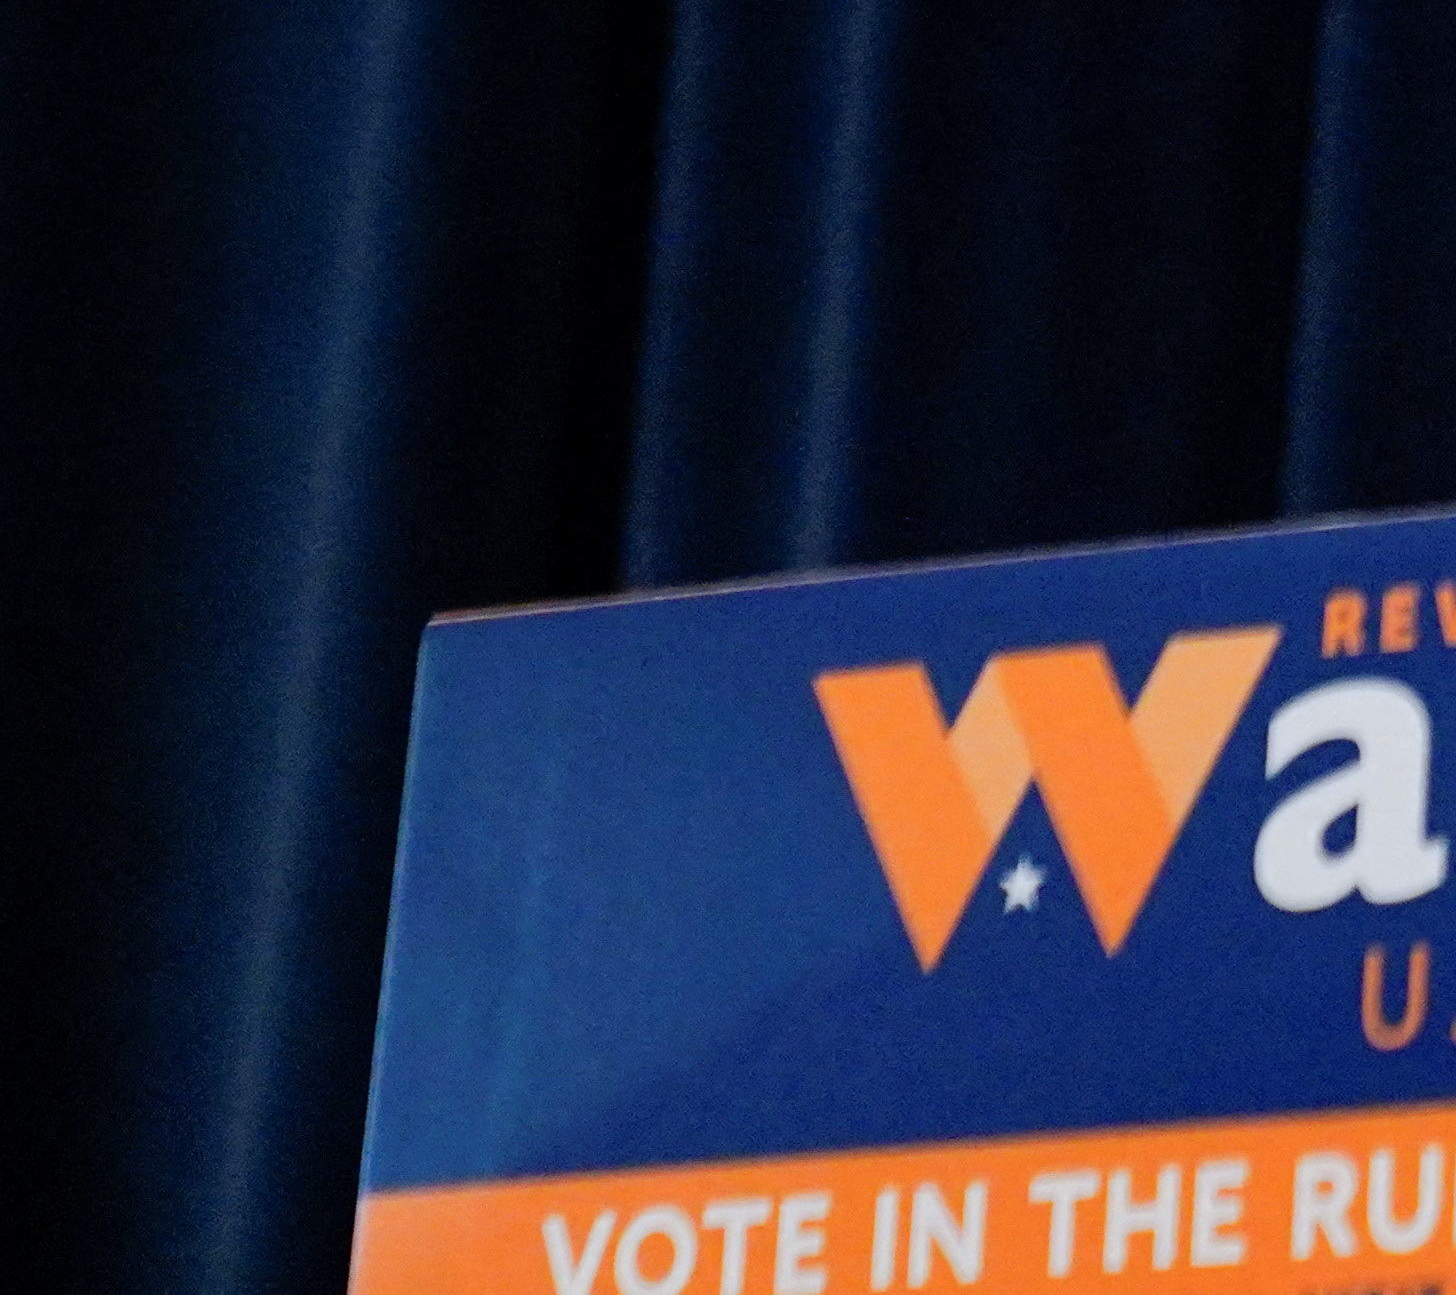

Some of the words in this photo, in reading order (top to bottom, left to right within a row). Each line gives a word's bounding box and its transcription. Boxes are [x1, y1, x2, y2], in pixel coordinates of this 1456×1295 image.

[541, 1189, 833, 1295] VOTE
[868, 1179, 989, 1292] IN
[1028, 1159, 1251, 1278] THE
